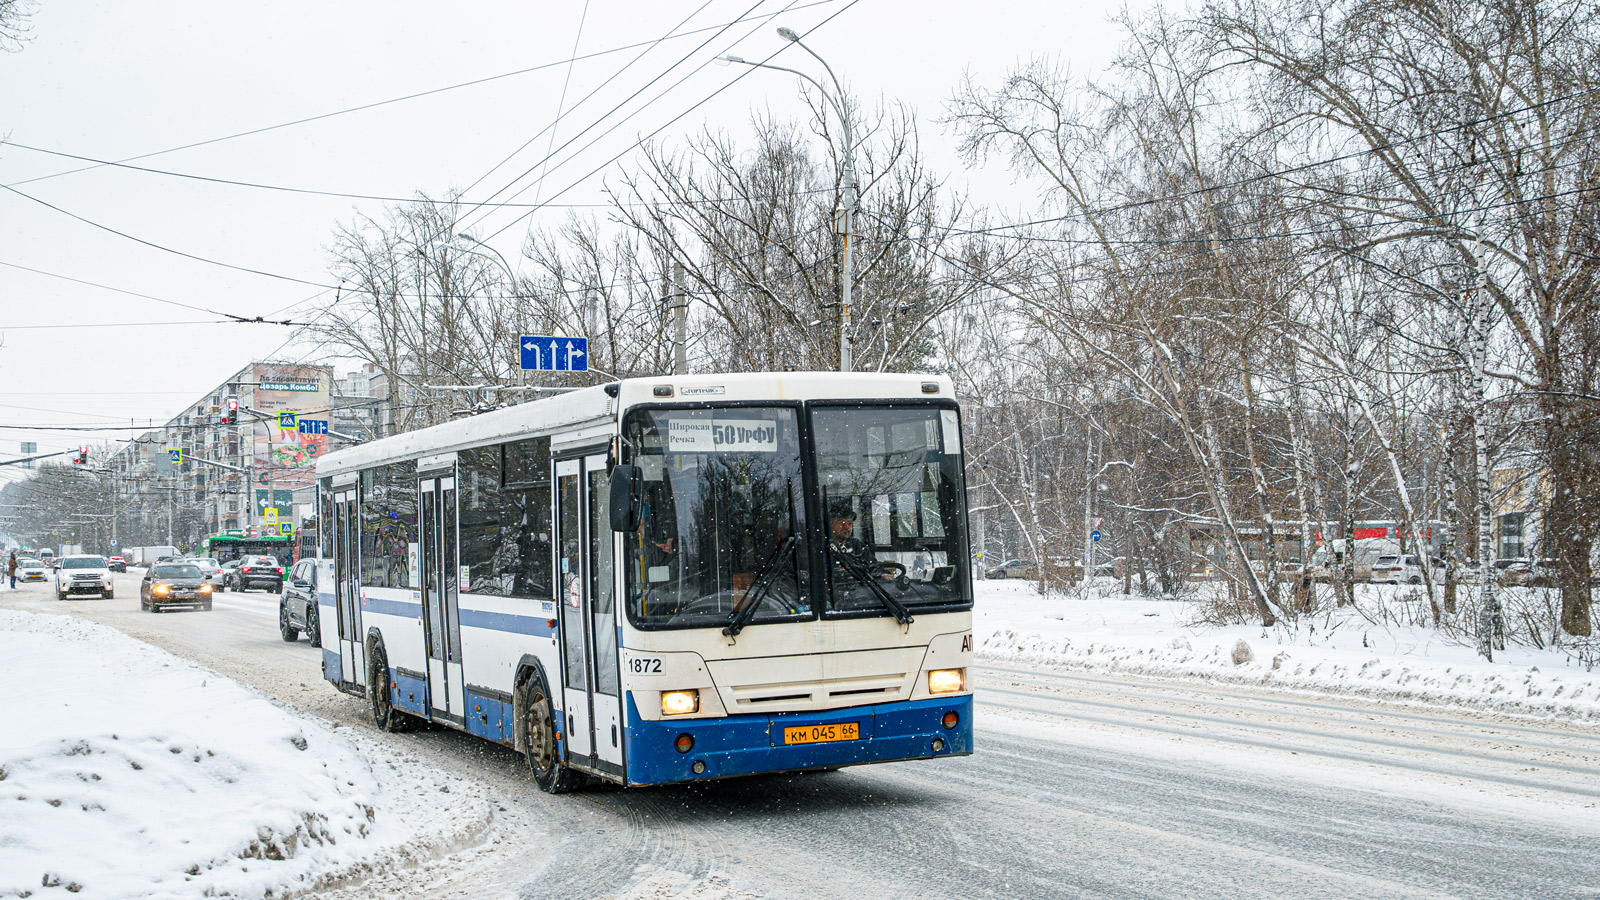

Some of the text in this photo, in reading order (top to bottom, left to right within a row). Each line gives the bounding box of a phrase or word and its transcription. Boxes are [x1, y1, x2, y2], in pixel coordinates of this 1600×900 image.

[670, 422, 710, 432] Широкая
[670, 436, 695, 444] Речка
[713, 424, 736, 445] 50
[628, 658, 662, 672] 1872
[791, 725, 854, 741] КМ 045 66
